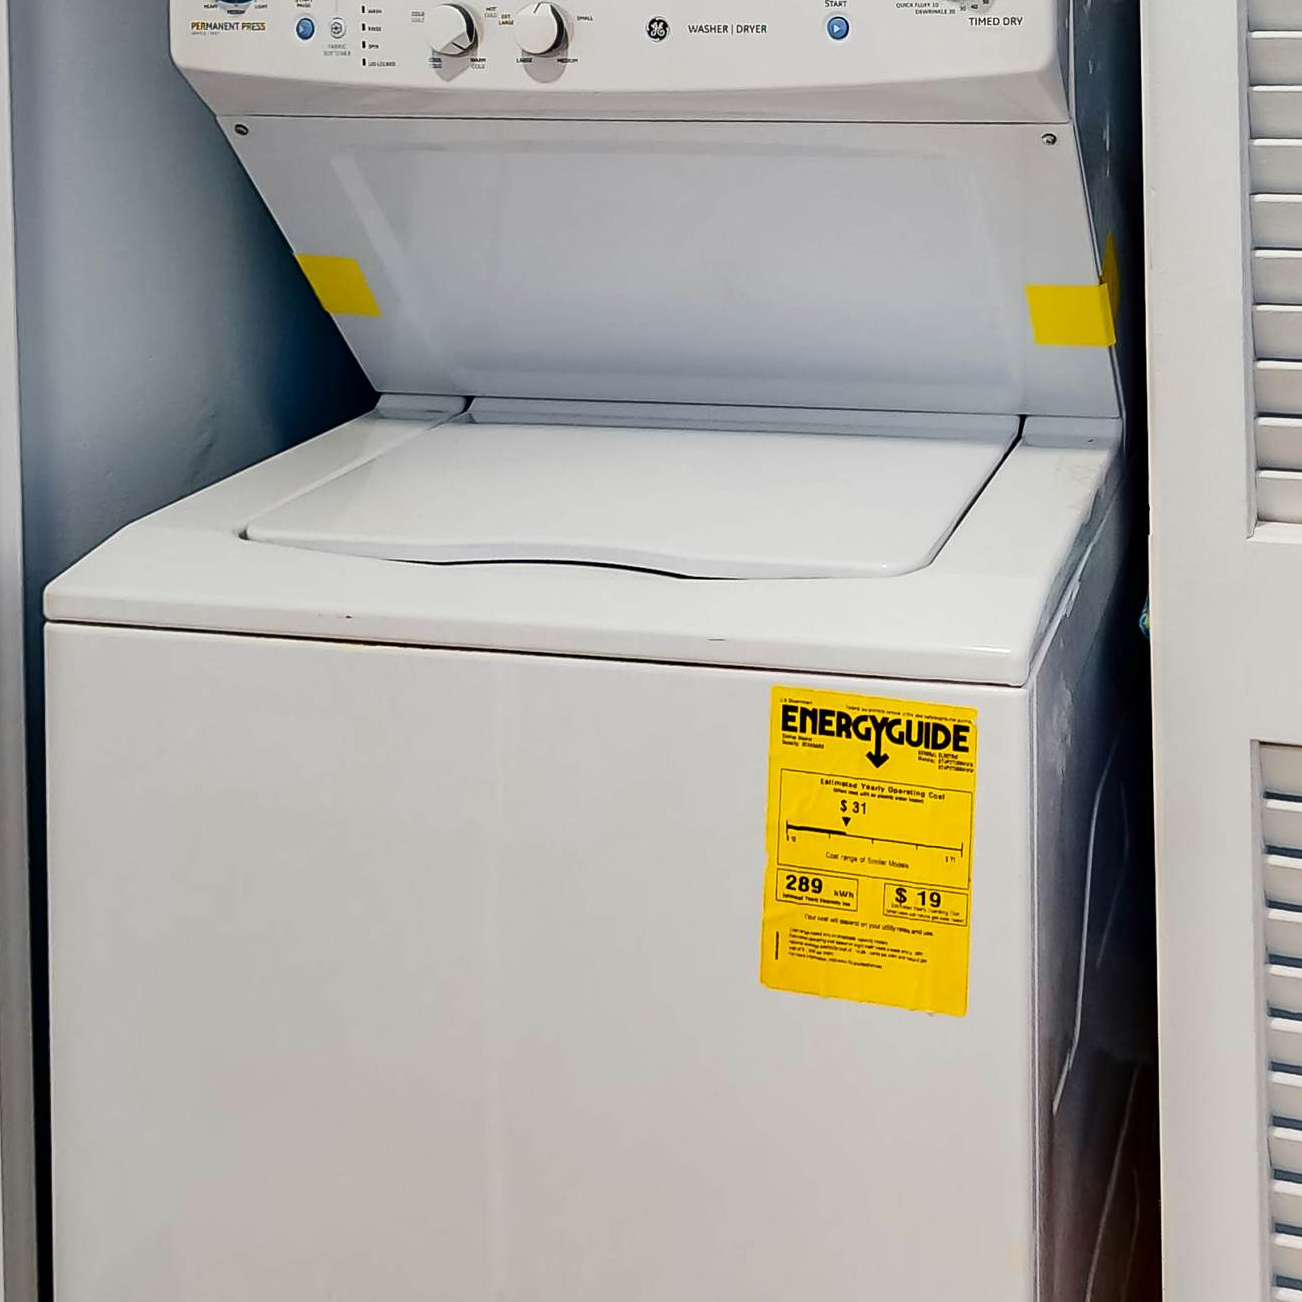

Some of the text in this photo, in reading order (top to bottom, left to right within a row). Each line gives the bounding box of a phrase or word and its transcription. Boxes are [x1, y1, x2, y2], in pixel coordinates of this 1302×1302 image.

[825, 0, 847, 8] START
[191, 22, 266, 31] PERMANENT PRESS
[968, 17, 1023, 25] TIMED DRY
[688, 24, 767, 34] WASHER DRYER
[782, 704, 970, 753] ENERGYGUIDE
[820, 778, 857, 788] Estimated
[861, 783, 885, 793] Yearly
[888, 786, 926, 798] Operating
[928, 791, 945, 800] Cost
[852, 801, 866, 814] 31
[786, 874, 854, 898] 289 kWh
[895, 887, 941, 908] $ 19
